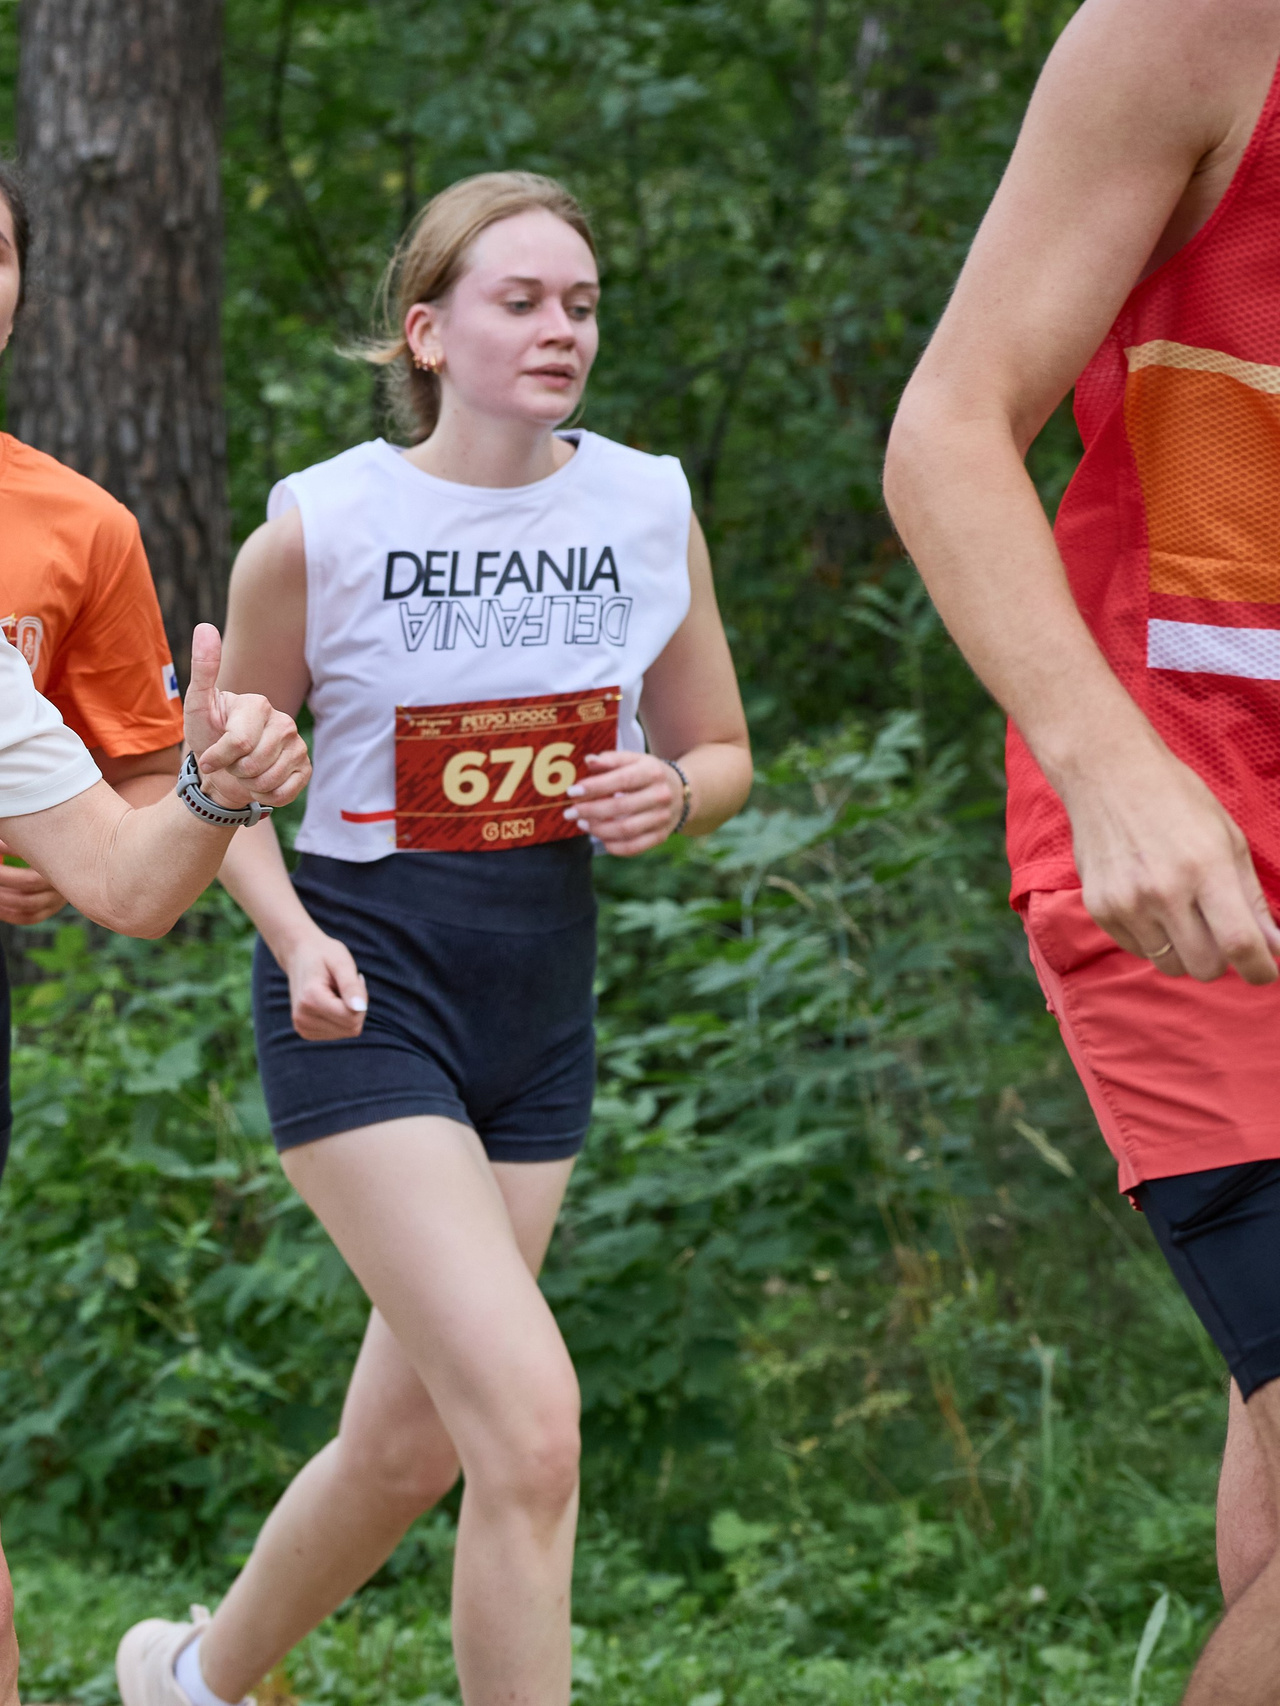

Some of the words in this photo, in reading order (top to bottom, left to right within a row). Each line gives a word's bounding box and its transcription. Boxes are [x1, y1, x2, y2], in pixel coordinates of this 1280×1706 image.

[383, 546, 620, 600] DELFANIA
[399, 595, 633, 651] DELFANIA
[509, 708, 558, 724] КРОСС
[443, 742, 576, 806] 676
[482, 822, 499, 841] 6
